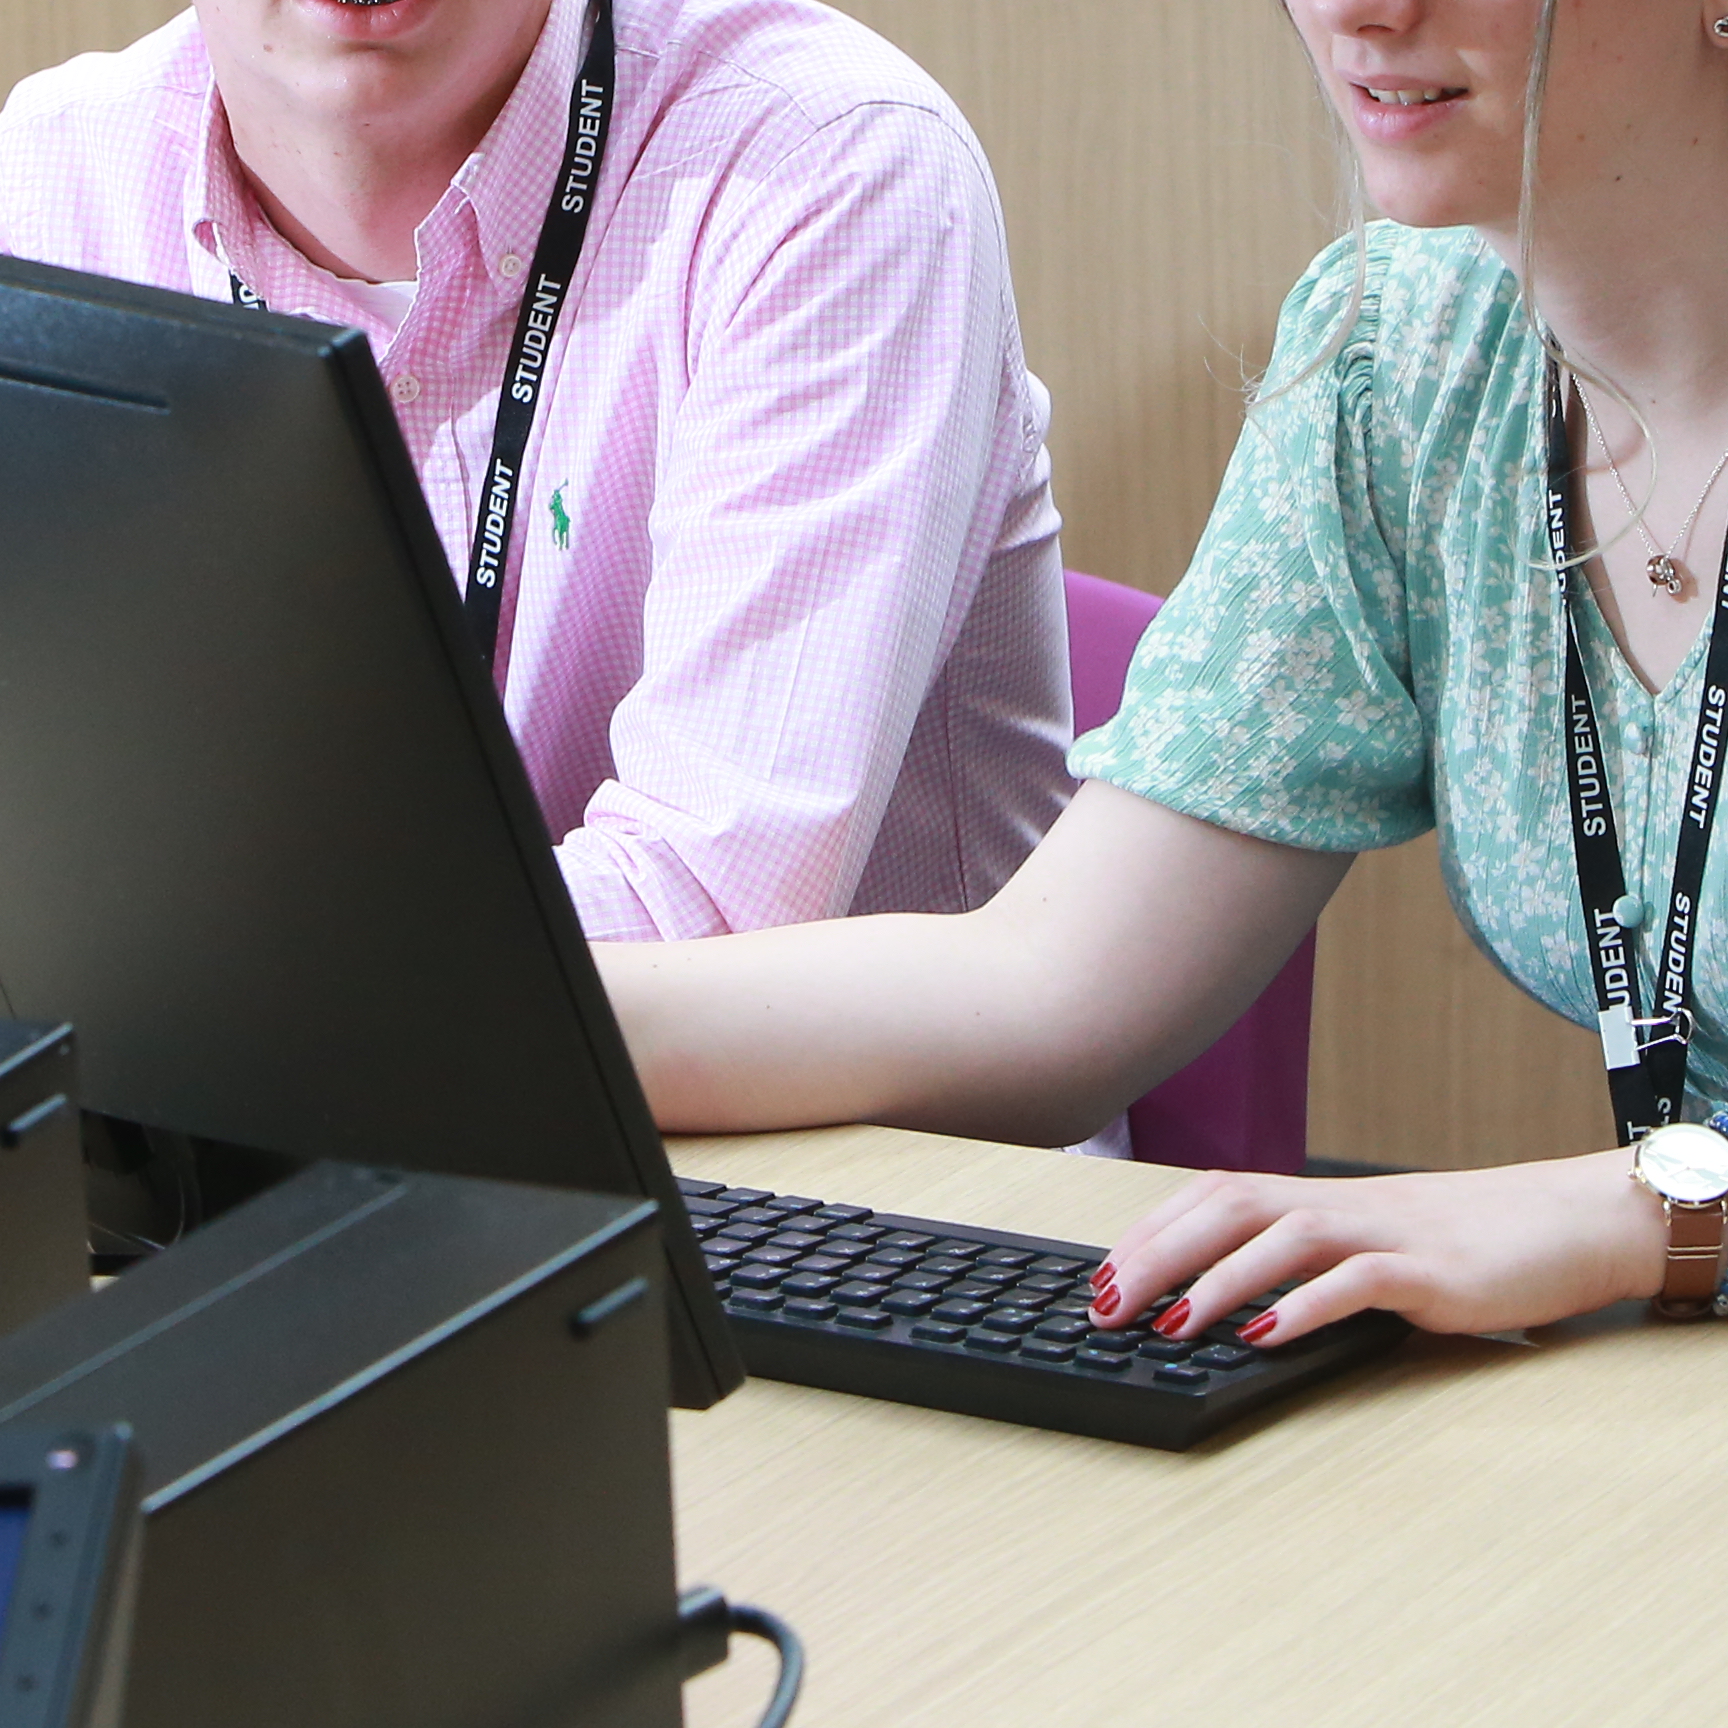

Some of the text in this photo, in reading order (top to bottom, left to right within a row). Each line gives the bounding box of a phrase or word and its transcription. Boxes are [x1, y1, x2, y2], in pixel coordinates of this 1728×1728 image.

[560, 78, 604, 214] STUDENT
[511, 273, 562, 404] STUDENT
[476, 458, 514, 589] STUDENT
[1571, 694, 1607, 838] STUDENT
[1688, 683, 1726, 829] STUDENT
[1594, 907, 1631, 1010] UDENT
[1662, 891, 1692, 1034] STUDEN
